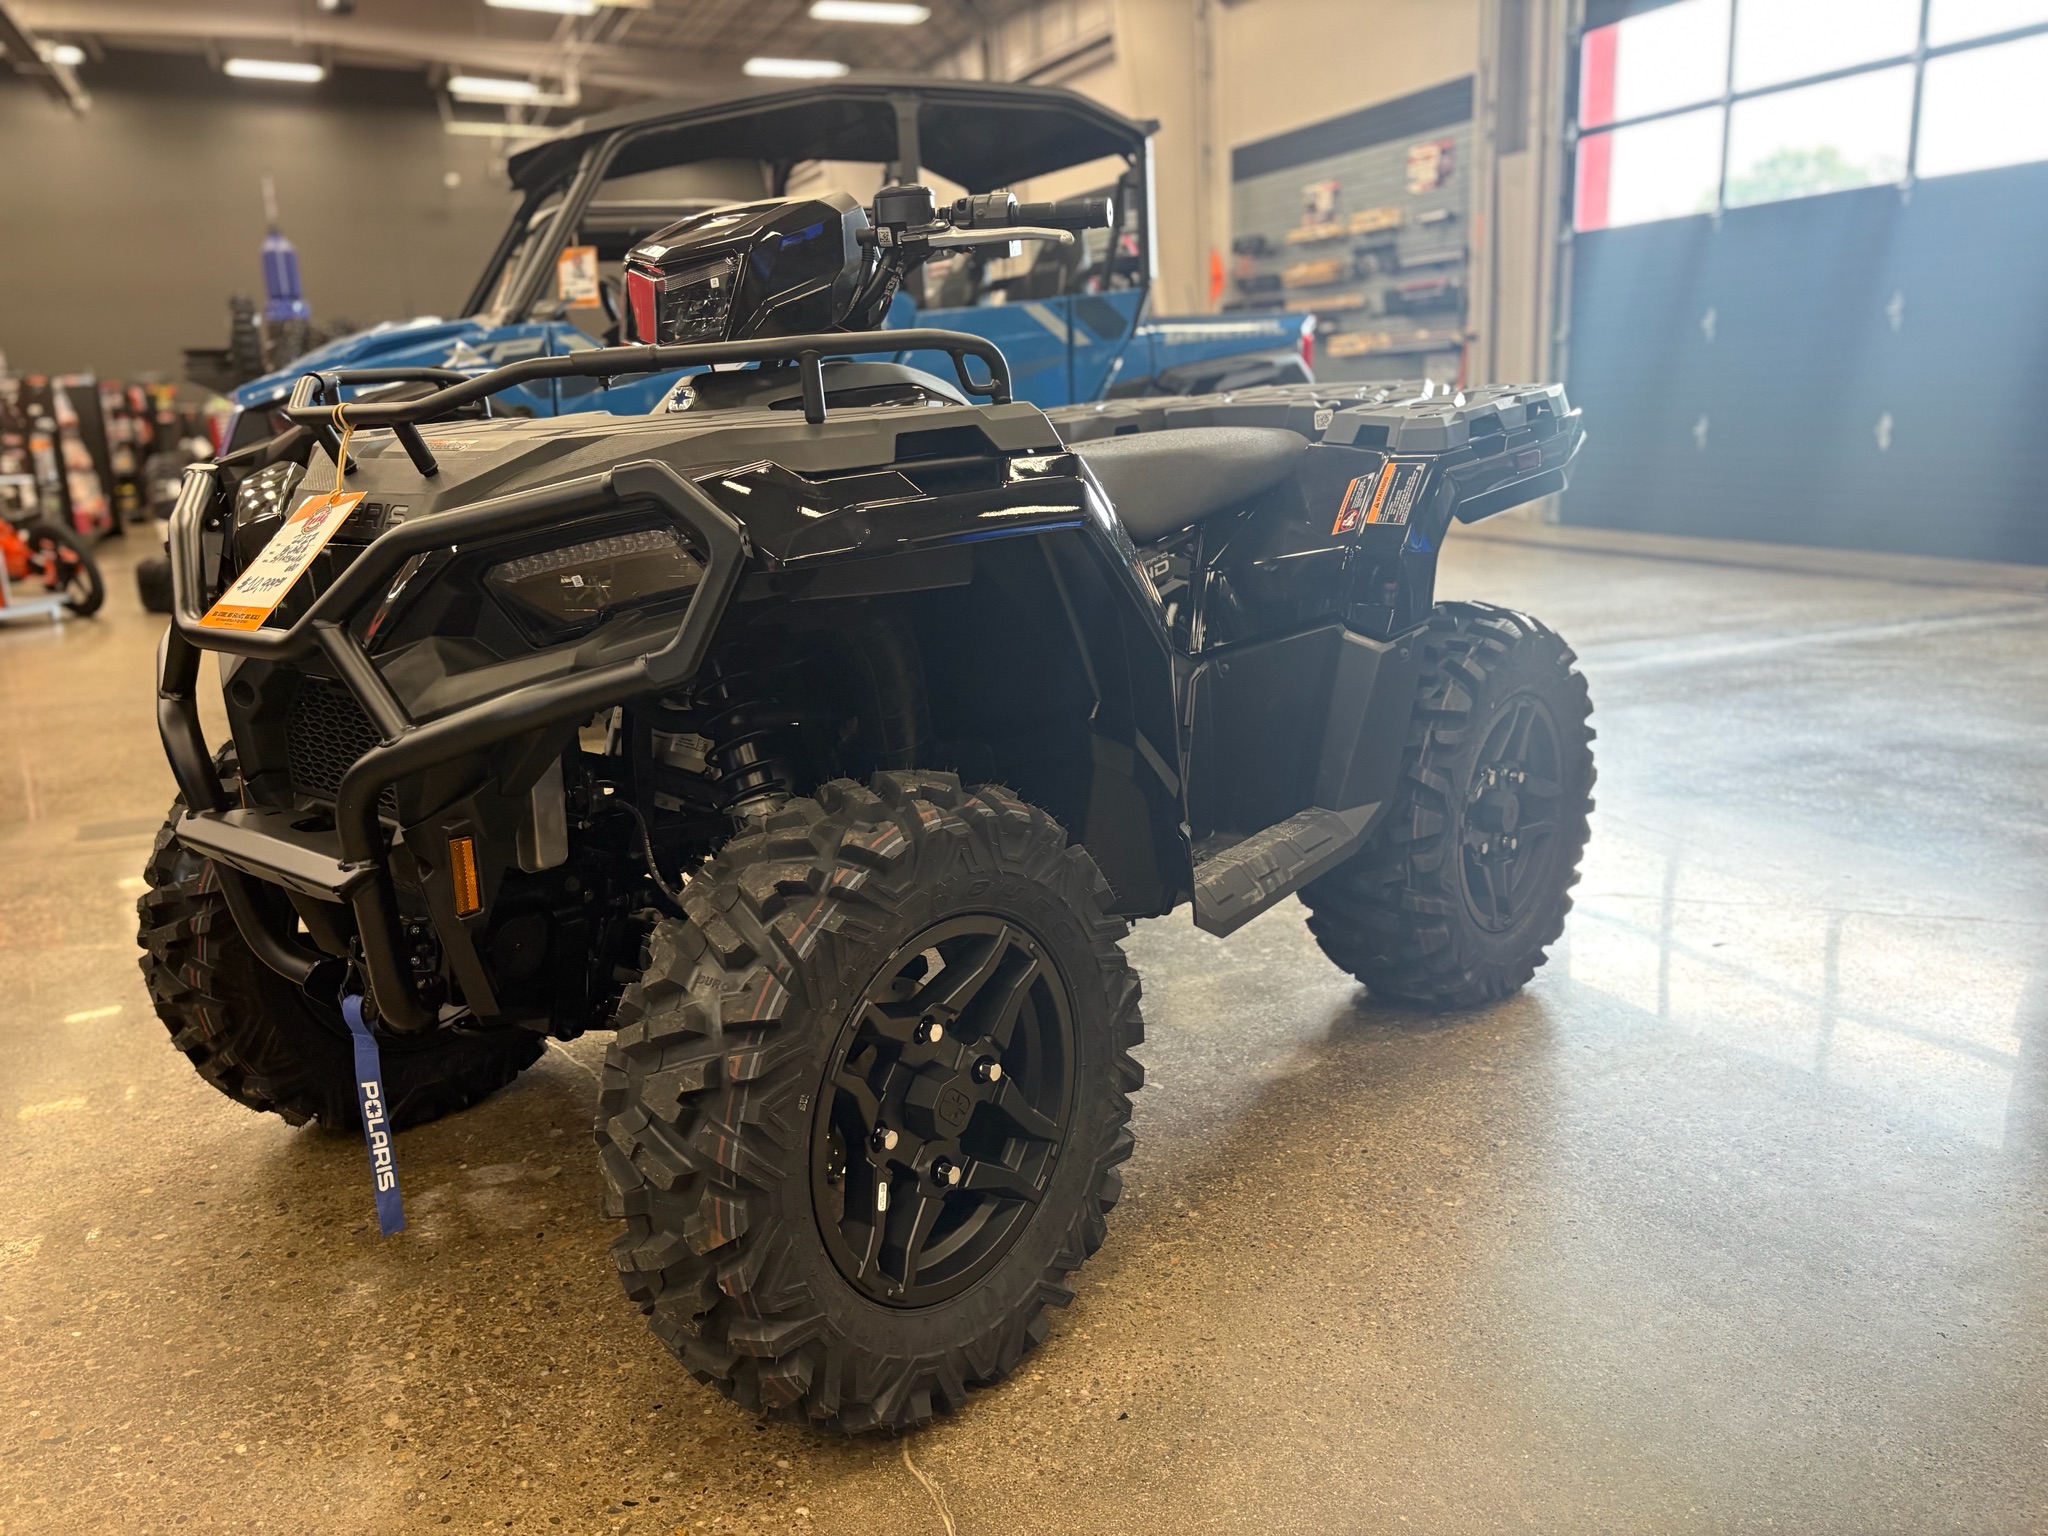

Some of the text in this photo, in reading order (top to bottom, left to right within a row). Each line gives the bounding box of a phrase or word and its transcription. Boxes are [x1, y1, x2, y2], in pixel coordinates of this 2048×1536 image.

[1376, 477, 1389, 503] WARNING
[347, 503, 409, 530] ARIS
[697, 974, 729, 991] DURO
[361, 1081, 395, 1192] POLARIS
